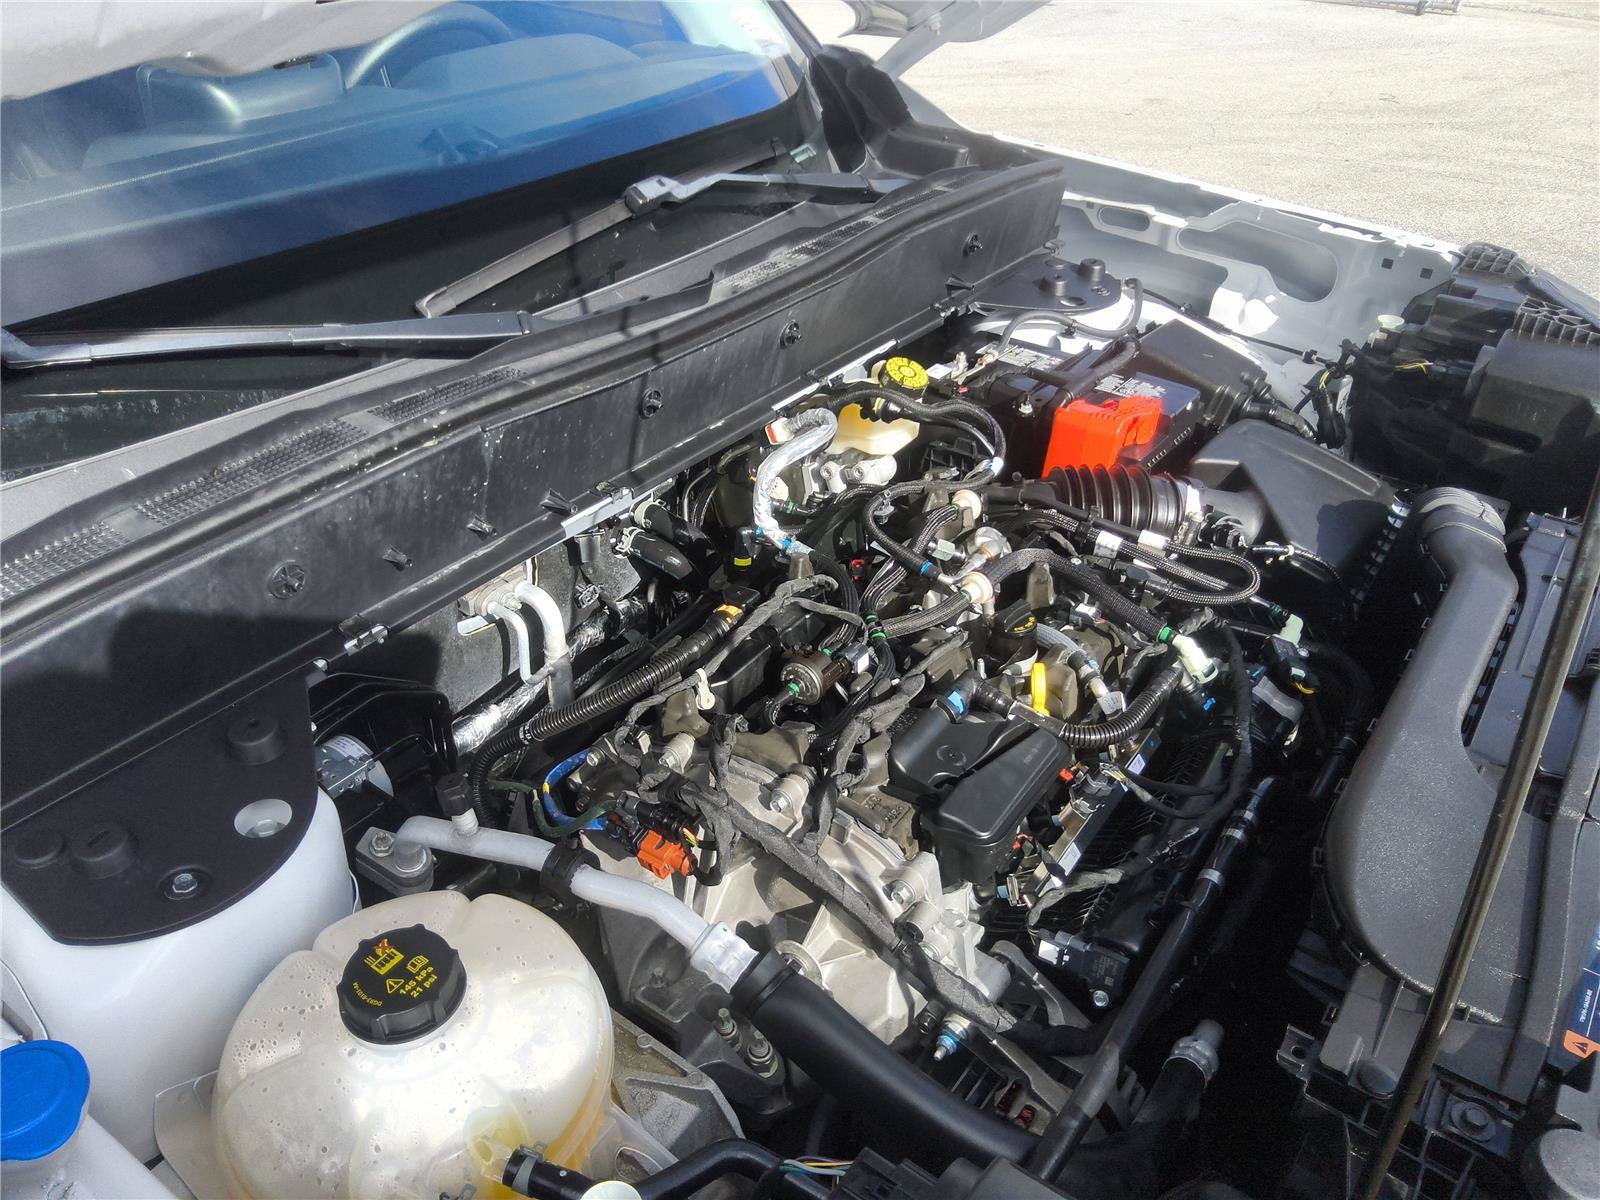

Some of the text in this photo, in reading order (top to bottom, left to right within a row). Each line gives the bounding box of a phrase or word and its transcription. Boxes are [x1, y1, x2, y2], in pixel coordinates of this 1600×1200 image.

[399, 966, 434, 994] 145 kPa
[410, 974, 437, 997] 21 psi
